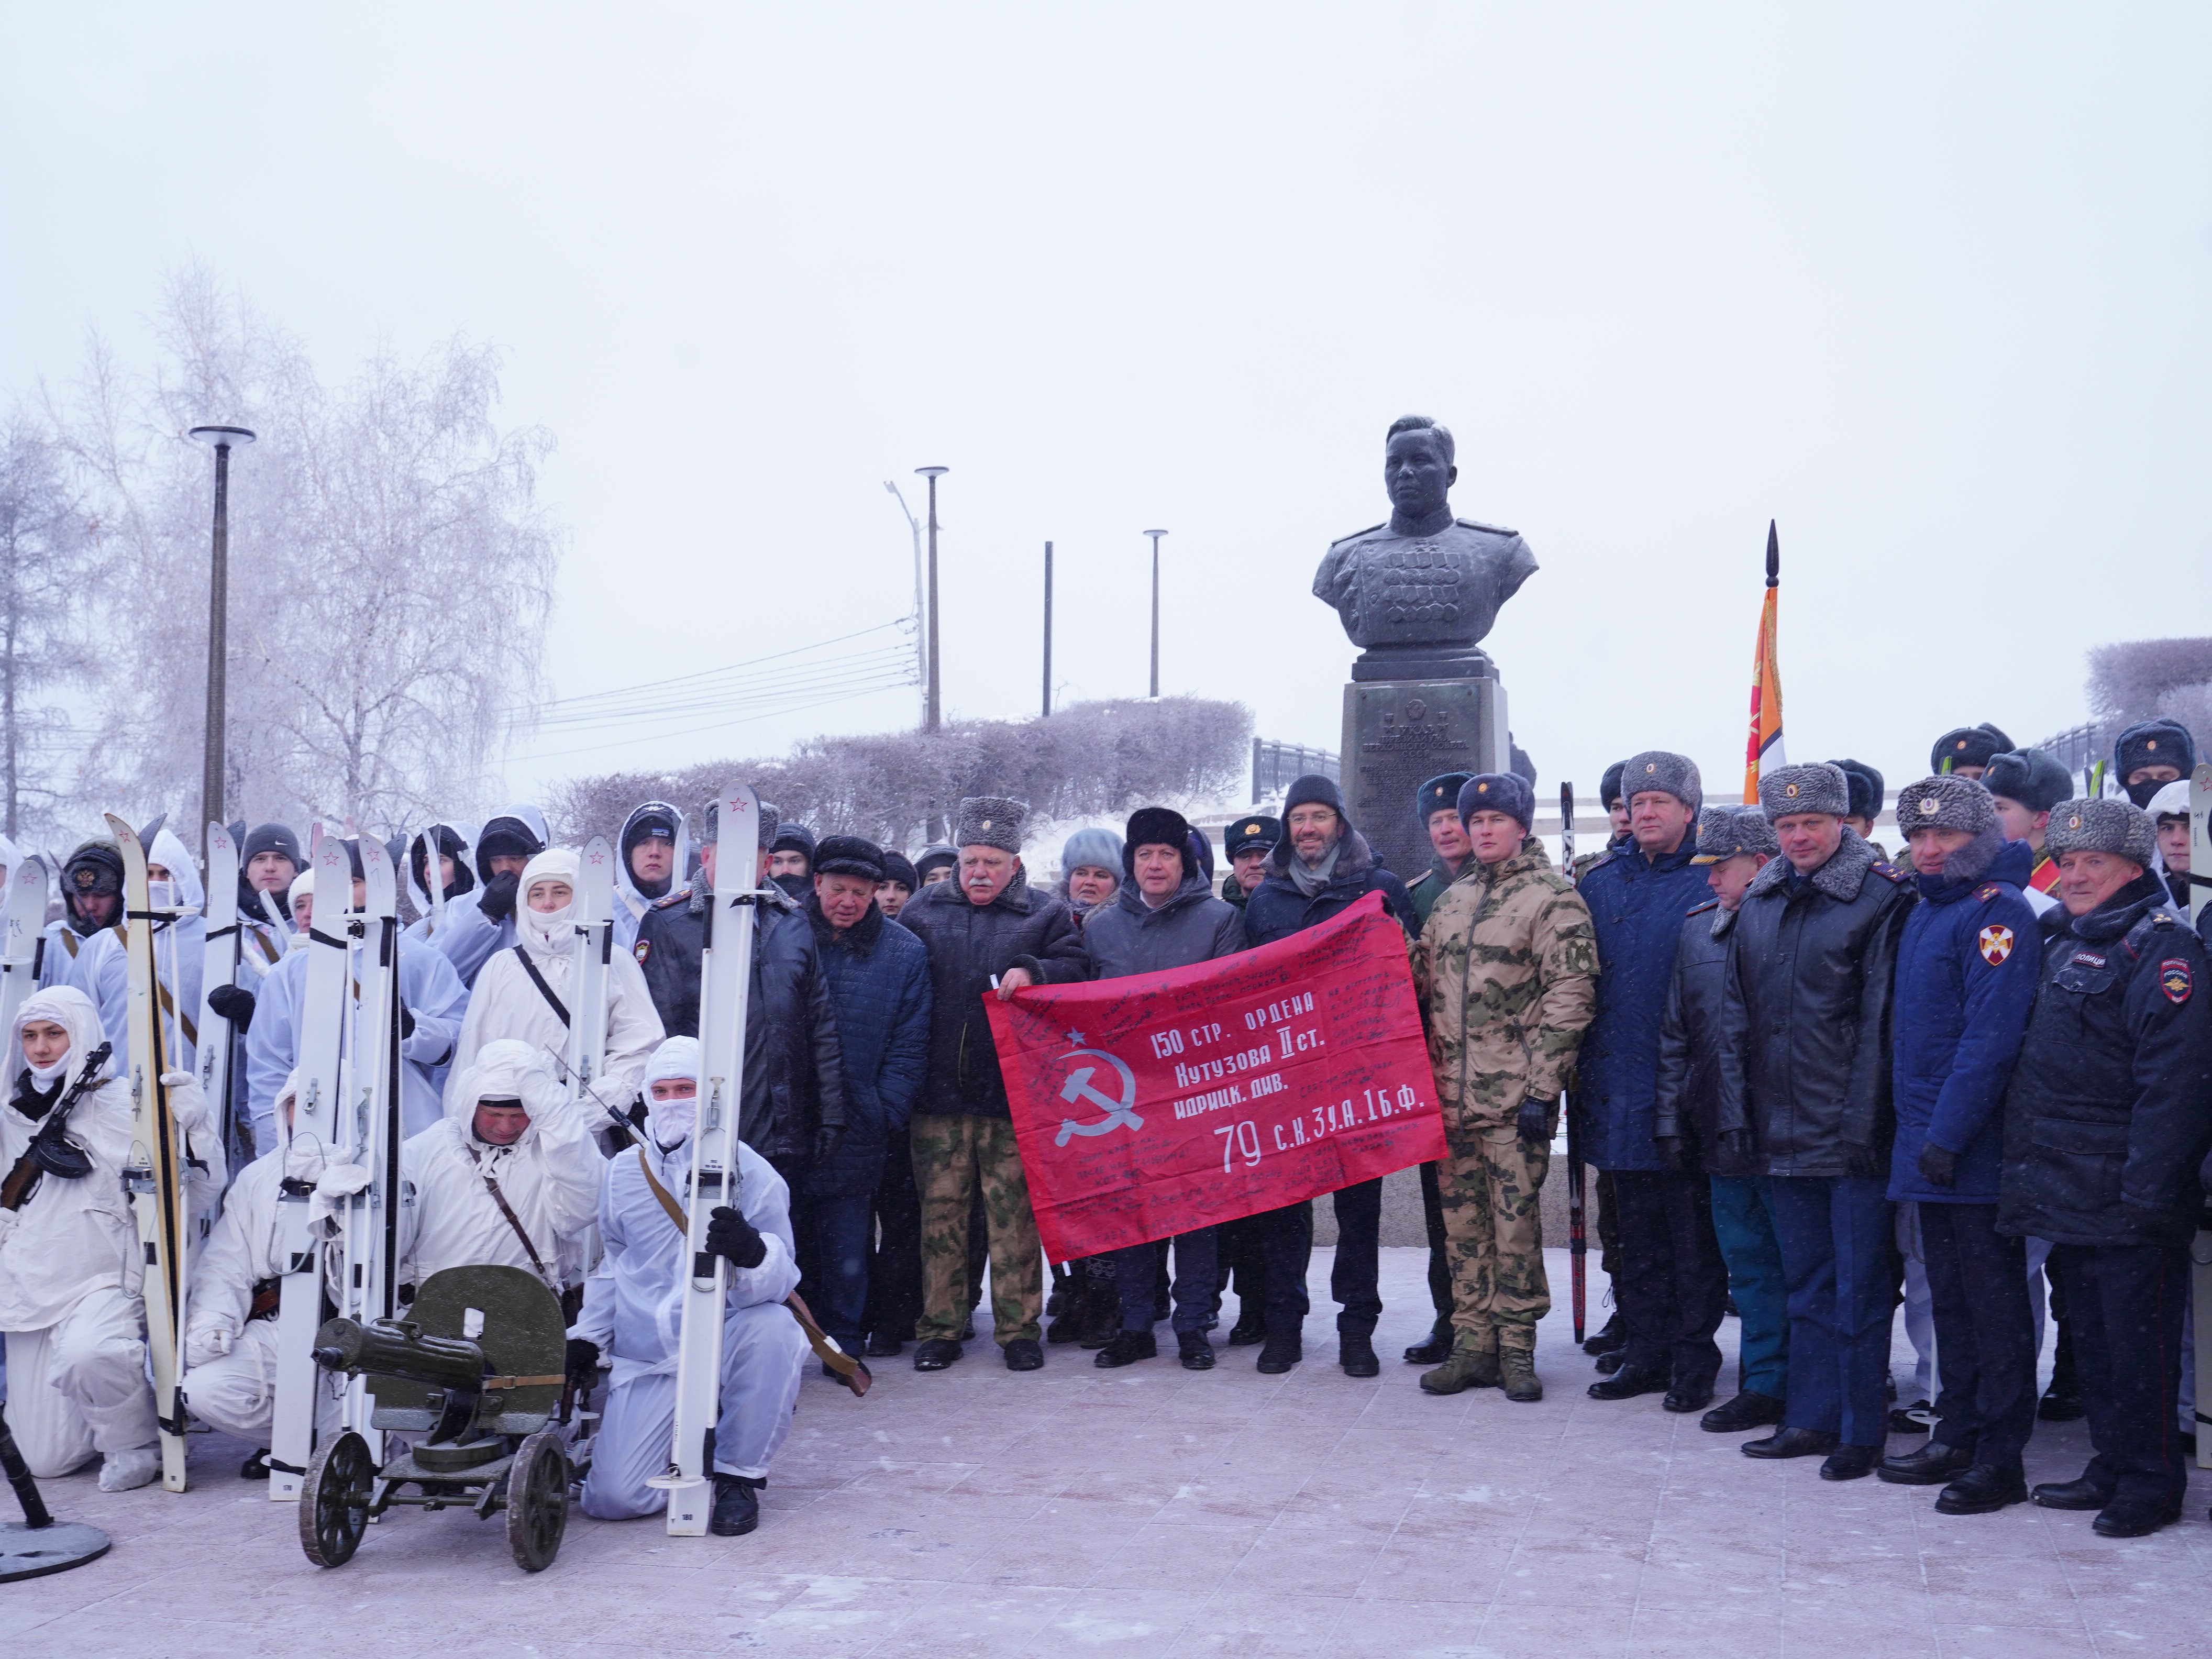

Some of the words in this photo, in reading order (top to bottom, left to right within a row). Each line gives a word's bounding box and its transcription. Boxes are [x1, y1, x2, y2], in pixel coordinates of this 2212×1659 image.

[1150, 1028, 1185, 1059] 150
[1244, 991, 1314, 1031] ОРДЕНА
[1173, 1085, 1247, 1120] ИДРИЦК.
[1250, 1073, 1289, 1100] ДИВ.
[1213, 1120, 1262, 1174] 79
